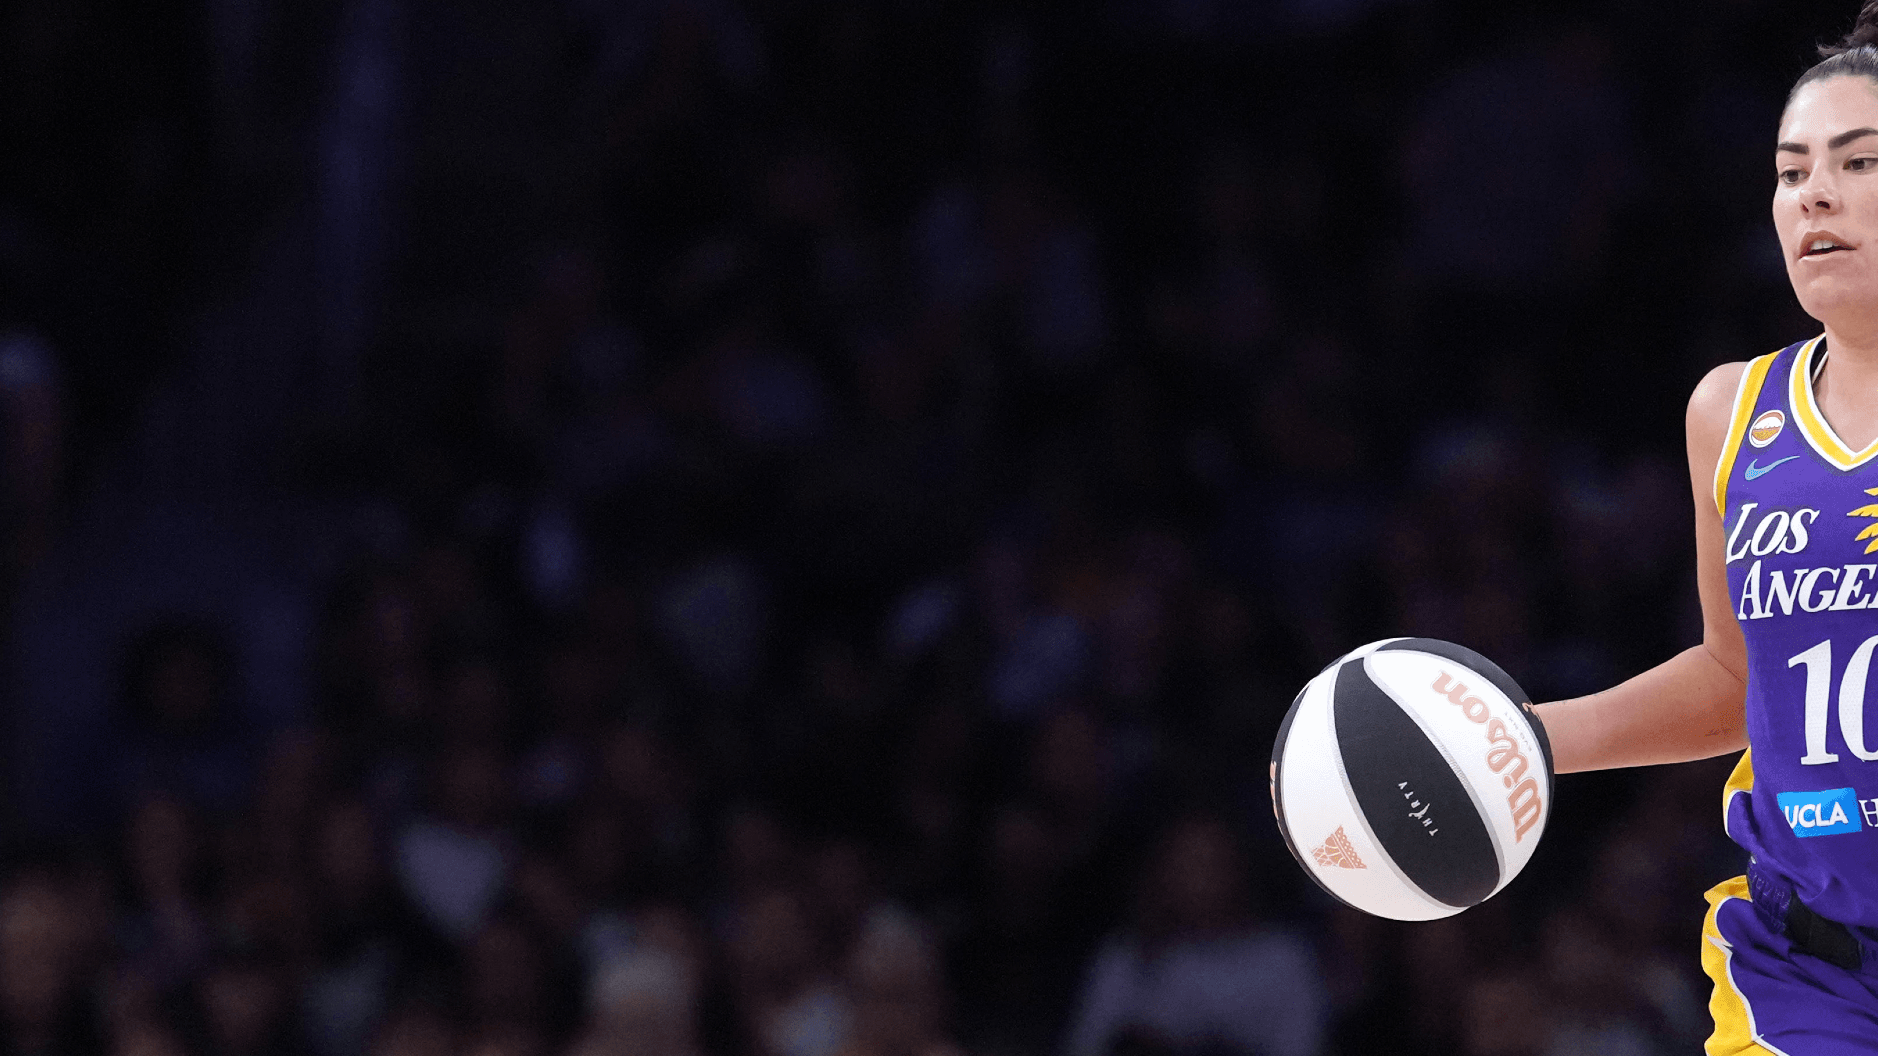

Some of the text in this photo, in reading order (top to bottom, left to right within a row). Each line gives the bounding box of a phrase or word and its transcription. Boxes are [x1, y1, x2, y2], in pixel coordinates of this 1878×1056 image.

[1725, 502, 1821, 565] LOS
[1431, 671, 1543, 844] Wilson
[1784, 801, 1850, 830] UCLA
